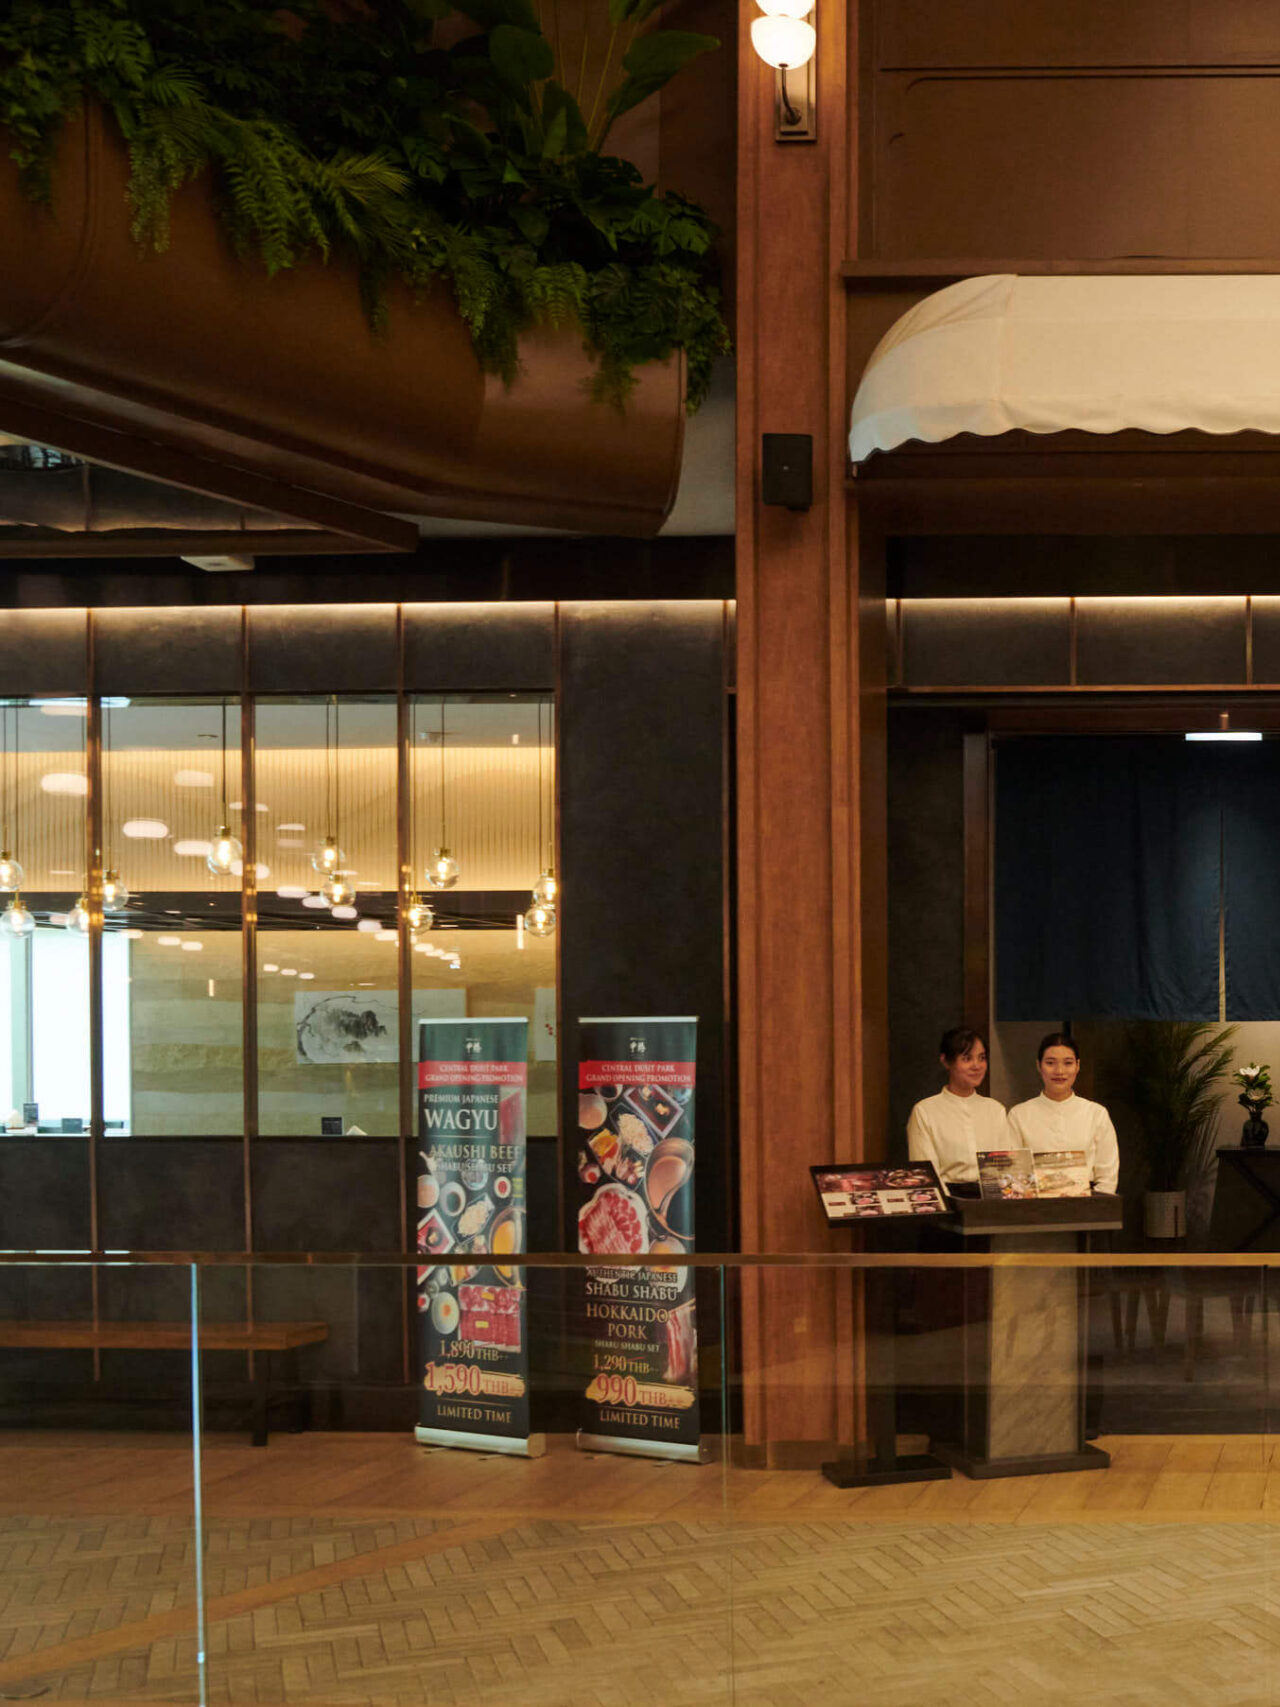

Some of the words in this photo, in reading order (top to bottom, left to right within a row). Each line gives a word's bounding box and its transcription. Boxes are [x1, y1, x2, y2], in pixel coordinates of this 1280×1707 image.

[601, 1064, 632, 1073] CENTRAL
[657, 1064, 676, 1073] PARK
[425, 1074, 449, 1082] GRAND
[449, 1074, 481, 1082] OPENING
[481, 1074, 523, 1082] PROMOTION
[586, 1073, 612, 1082] GRAND
[613, 1073, 646, 1082] OPENING
[647, 1074, 692, 1083] PROMOTION
[424, 1094, 460, 1103] PREMIUM
[462, 1094, 499, 1104] JAPANESE
[424, 1108, 499, 1131] WAGYU
[429, 1144, 485, 1159] AKAUSHI
[490, 1145, 520, 1160] BEEF
[497, 1163, 513, 1173] SET
[586, 1269, 636, 1281] AUTHENTIC
[638, 1270, 678, 1283] JAPANESE
[585, 1282, 629, 1298] SHABU
[633, 1284, 678, 1301] SHABU
[586, 1302, 669, 1323] HOKKAIDO
[608, 1322, 648, 1340] PORK
[595, 1339, 619, 1349] SHABU
[620, 1340, 645, 1351] SHABU
[647, 1343, 660, 1352] SET
[426, 1362, 480, 1394] 1,590
[596, 1374, 637, 1406] 990
[437, 1404, 482, 1420] LIMITED
[484, 1408, 513, 1423] TIME
[600, 1411, 649, 1427] LIMITED
[651, 1415, 681, 1430] TIME
